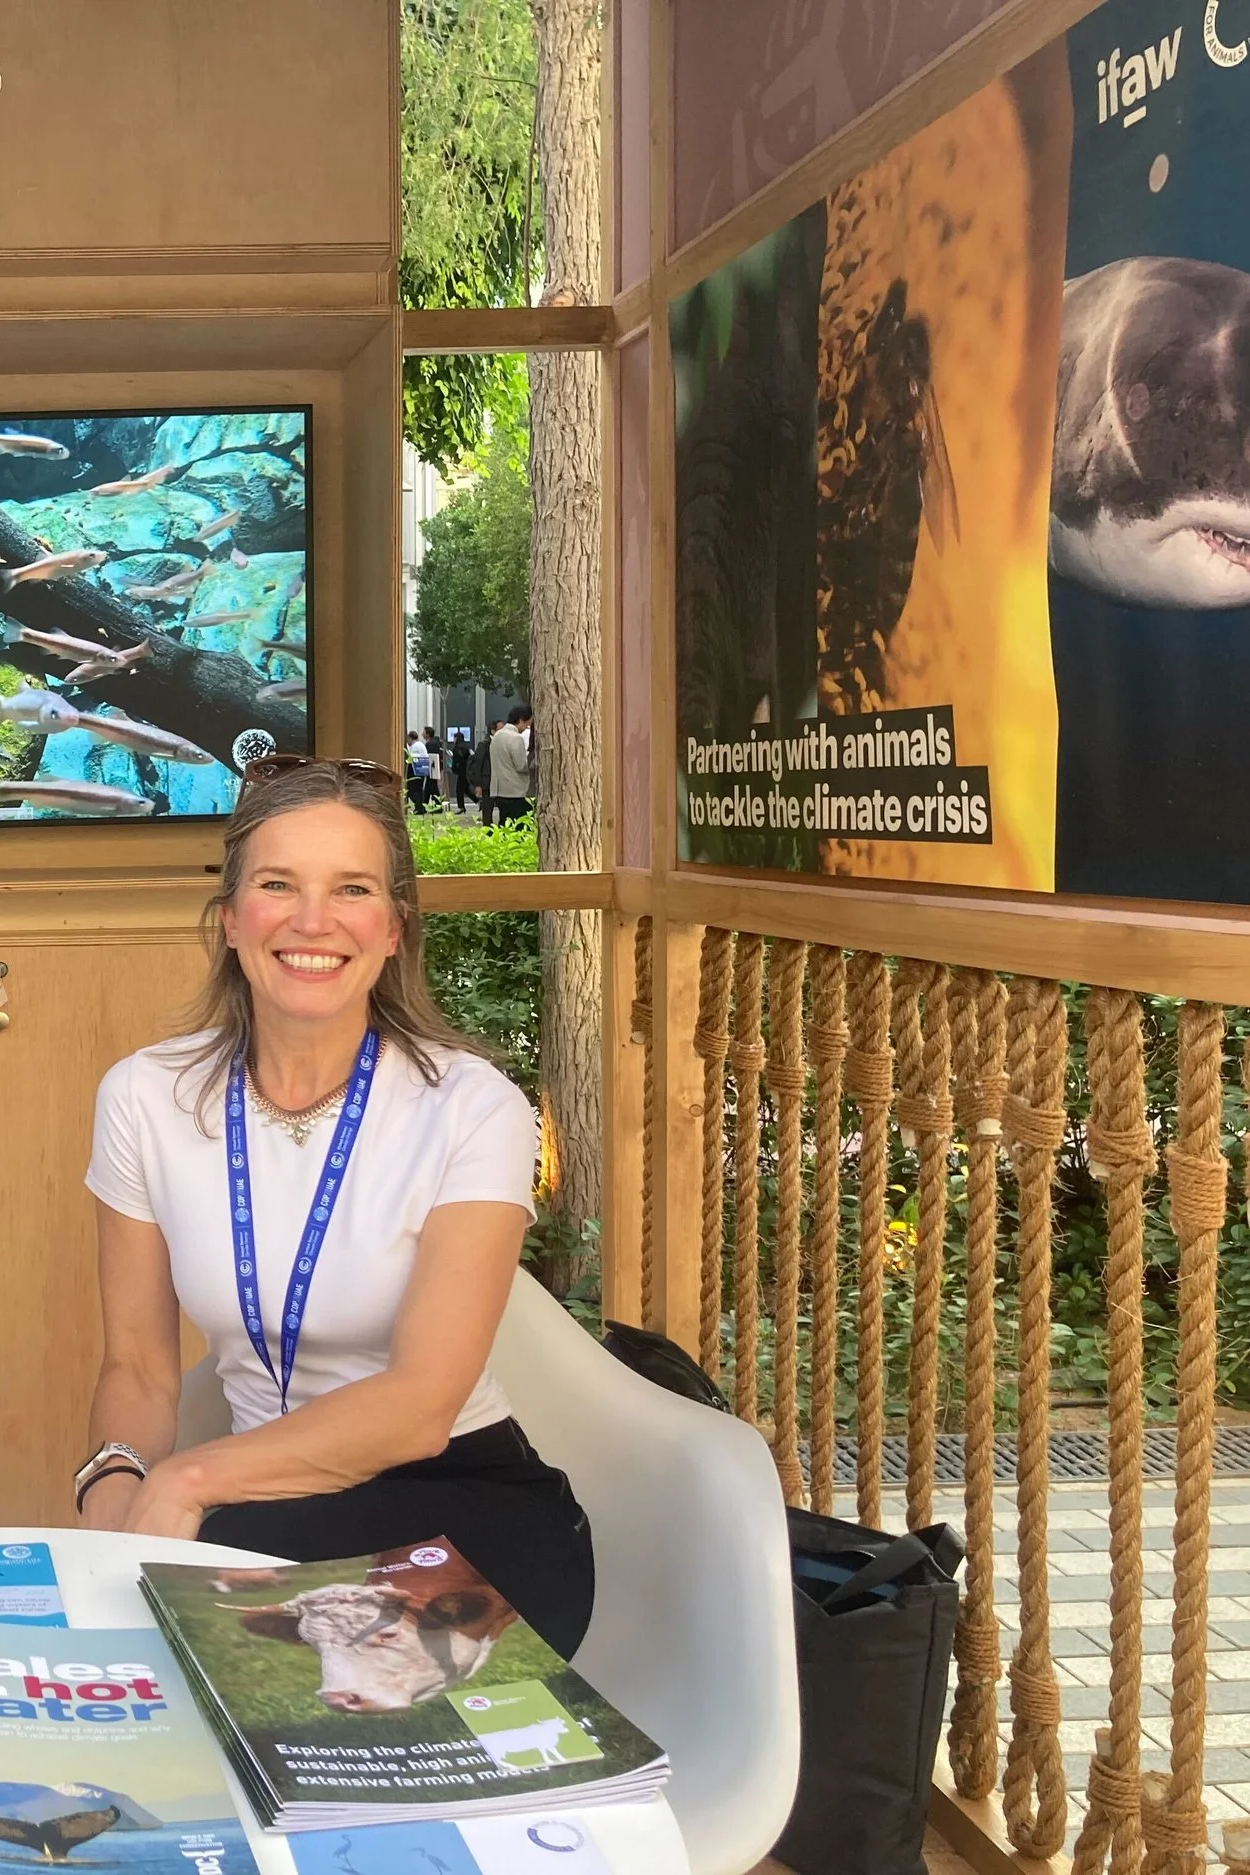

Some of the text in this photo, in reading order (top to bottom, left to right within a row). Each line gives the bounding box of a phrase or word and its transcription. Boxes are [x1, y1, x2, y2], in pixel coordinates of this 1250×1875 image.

[1206, 6, 1244, 64] FOR ANIMALS
[1097, 26, 1182, 124] ifaw
[687, 713, 951, 781] Partnering with animals
[689, 780, 988, 834] to tackle the climate crisis
[23, 1676, 163, 1700] hot
[275, 1738, 481, 1758] Exploring the climate
[286, 1759, 407, 1773] sustainable,
[408, 1757, 452, 1771] high
[296, 1774, 390, 1787] extensive
[394, 1771, 475, 1787] farming
